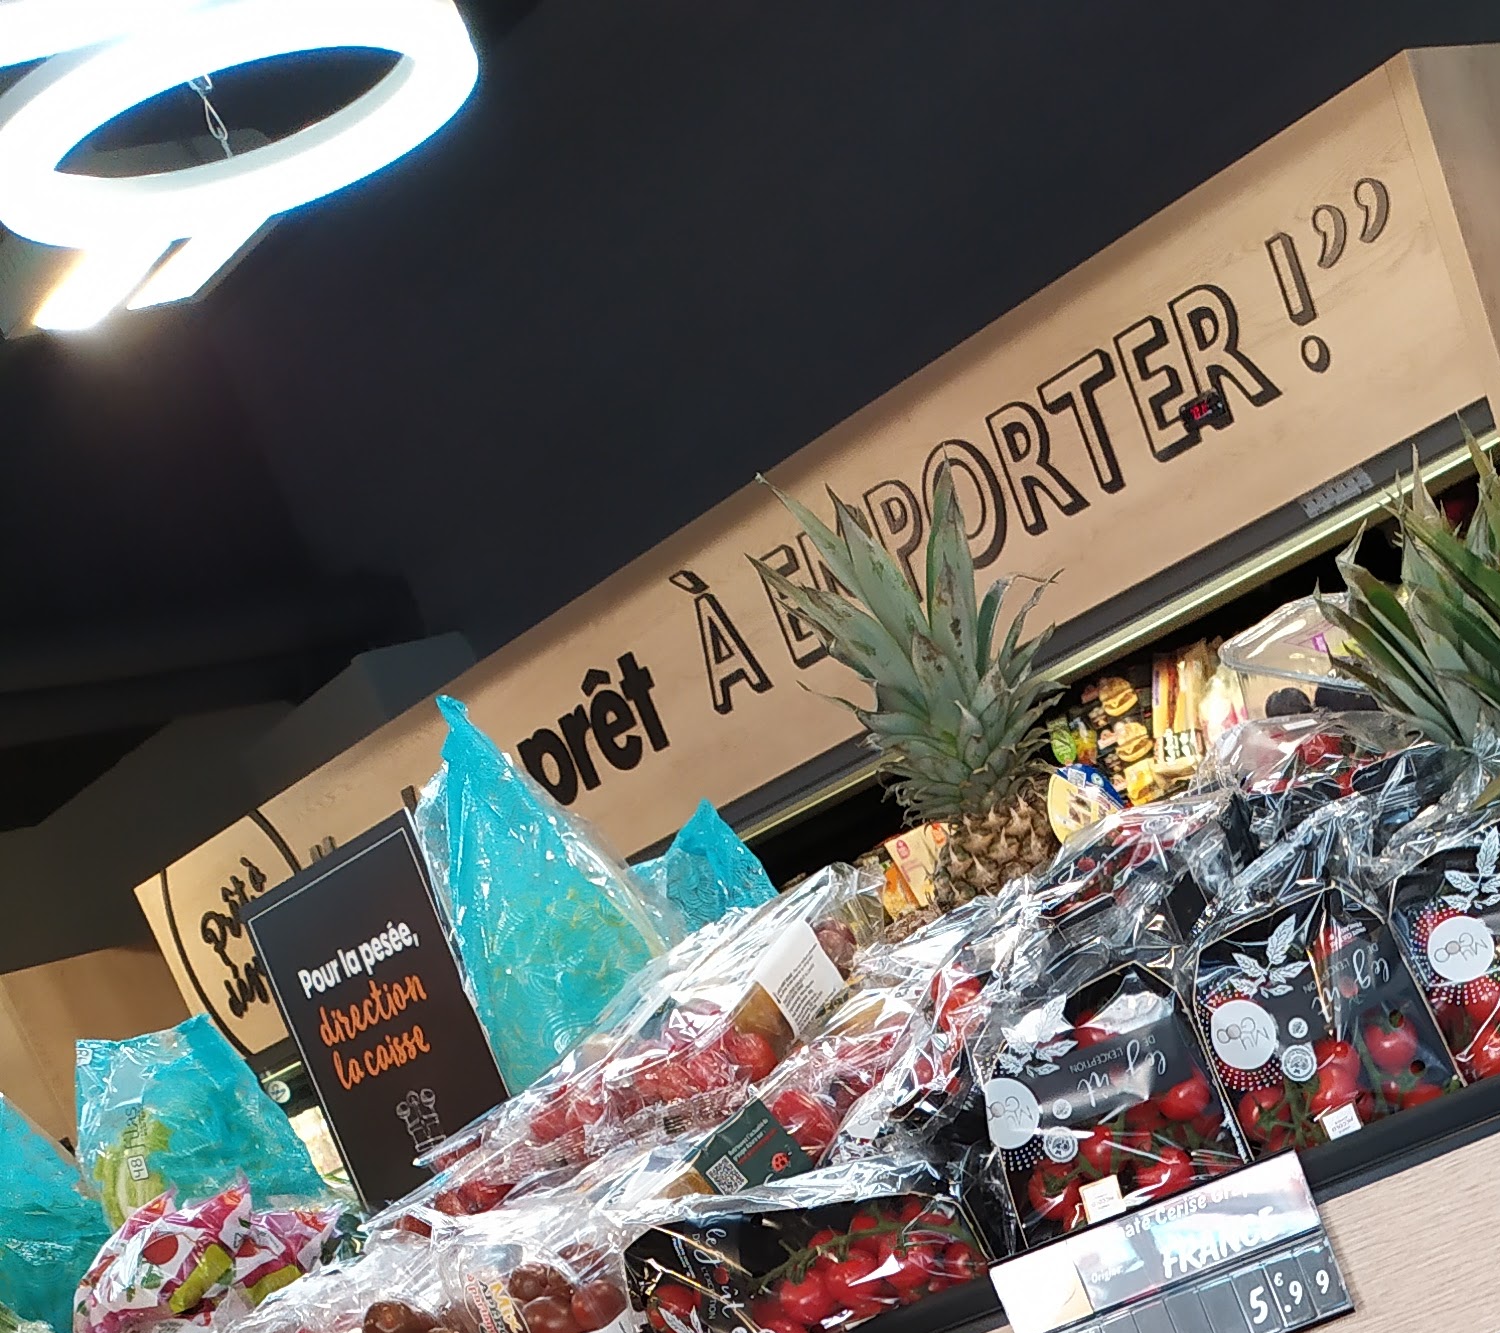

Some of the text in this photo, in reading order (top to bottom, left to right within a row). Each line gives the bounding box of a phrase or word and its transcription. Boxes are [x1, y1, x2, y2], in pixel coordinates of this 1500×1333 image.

[297, 958, 342, 999] Pour
[336, 949, 363, 978] la
[358, 920, 421, 976] pesée,
[319, 974, 428, 1048] direction
[332, 1024, 432, 1090] la caisse
[1154, 1197, 1208, 1227] Cerise
[1162, 1206, 1280, 1280] FRANCE
